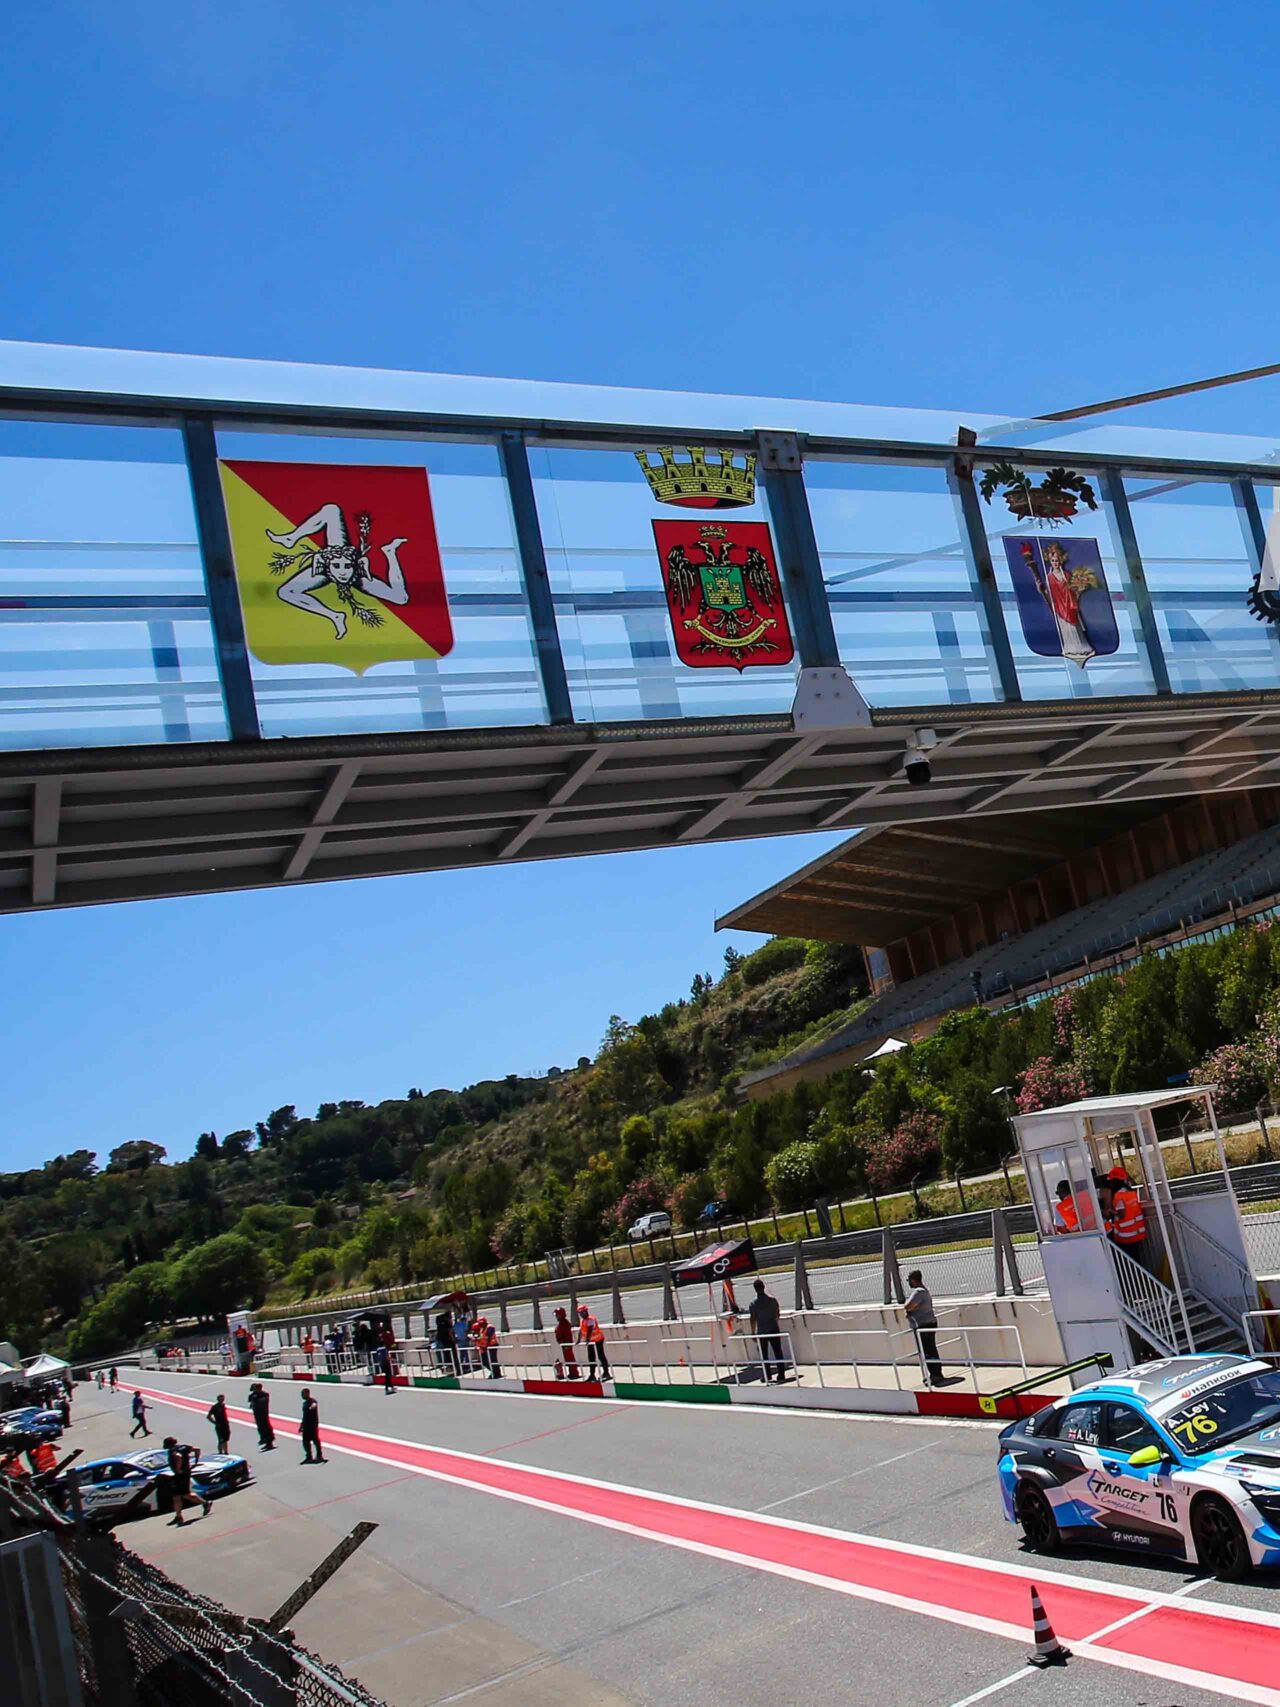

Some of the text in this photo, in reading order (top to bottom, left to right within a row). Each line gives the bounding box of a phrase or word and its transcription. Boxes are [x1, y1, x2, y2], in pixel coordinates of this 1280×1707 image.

[1167, 1402, 1210, 1429] A. Ley
[1077, 1429, 1084, 1440] A.
[1173, 1415, 1218, 1444] 76
[1092, 1480, 1149, 1503] TARGET
[1156, 1492, 1177, 1523] 76
[1122, 1533, 1150, 1545] HYUNDAI
